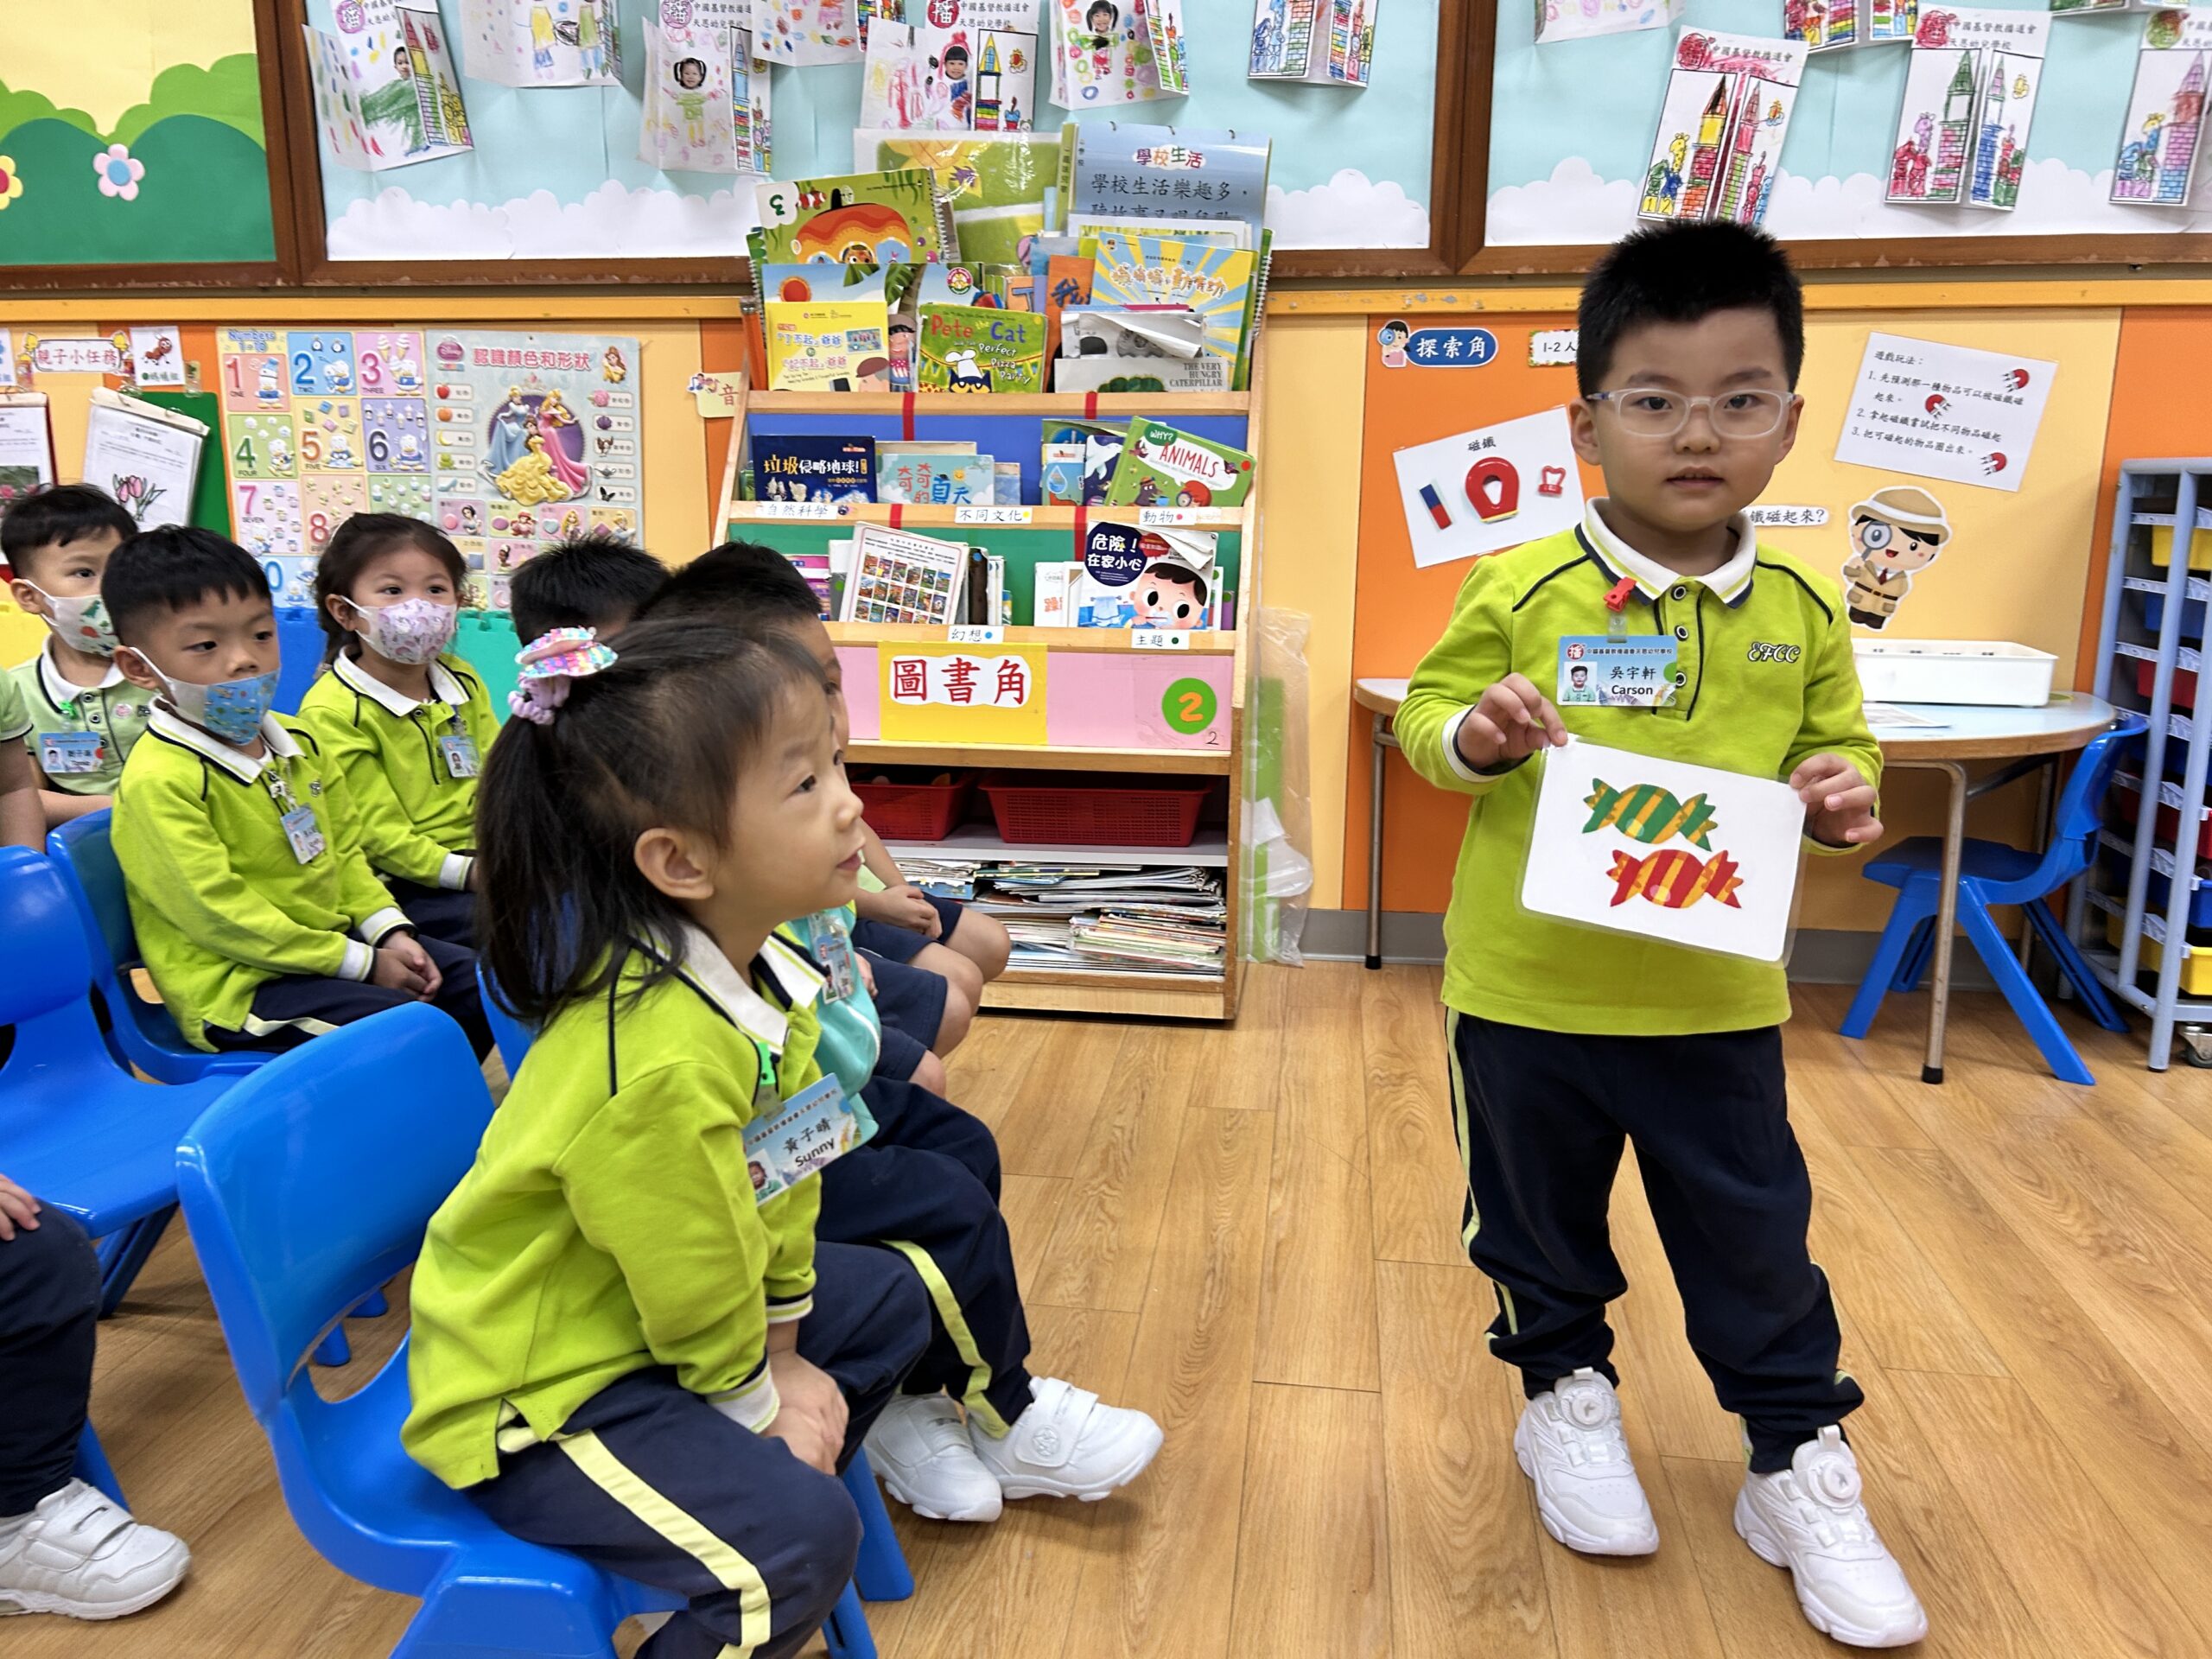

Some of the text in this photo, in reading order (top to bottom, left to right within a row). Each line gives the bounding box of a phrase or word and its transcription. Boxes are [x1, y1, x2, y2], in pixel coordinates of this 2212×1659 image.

[1136, 146, 1204, 168] 學校生活
[228, 330, 276, 341] Numbers
[931, 315, 974, 339] Pete
[990, 321, 1027, 343] Cat
[978, 343, 1017, 357] Perfect
[1415, 335, 1487, 359] 探索角
[37, 349, 118, 366] 親子小任務
[474, 348, 592, 372] 認識顏色和形狀
[990, 359, 1016, 369] Pizza
[1184, 362, 1202, 371] THE
[226, 358, 240, 388] 1
[294, 353, 315, 385] 2
[361, 353, 381, 385] 3
[1000, 371, 1031, 385] Party
[1189, 371, 1223, 379] HUNGRY
[1169, 378, 1223, 387] CATERPILLAR
[718, 384, 739, 405] 音
[1150, 429, 1173, 442] WHY?
[1468, 436, 1497, 451] 磁鐵
[237, 437, 256, 468] 4
[302, 431, 321, 461] 5
[369, 431, 388, 462] 6
[764, 454, 859, 474] 垃圾侵略地球!
[1160, 442, 1219, 477] ANIMALS
[239, 486, 257, 514] 7
[768, 505, 829, 518] 自然科學
[960, 509, 1022, 523] 不同文化
[1143, 511, 1173, 524] 動物
[1745, 510, 1825, 524] 鐵磁起來?
[310, 513, 329, 543] 8
[1091, 533, 1138, 553] 危險！
[1087, 554, 1142, 571] 在家小心
[951, 628, 982, 642] 幻想
[1137, 634, 1164, 646] 主題
[1747, 641, 1802, 663] EFCC
[893, 657, 1027, 705] 圖書角
[1611, 666, 1656, 680] 吳宇軒
[1611, 685, 1653, 695] Carson
[1178, 692, 1204, 721] 2
[1207, 731, 1219, 746] 2
[784, 1117, 832, 1154] 黃子晴
[794, 1137, 836, 1168] Sunny
